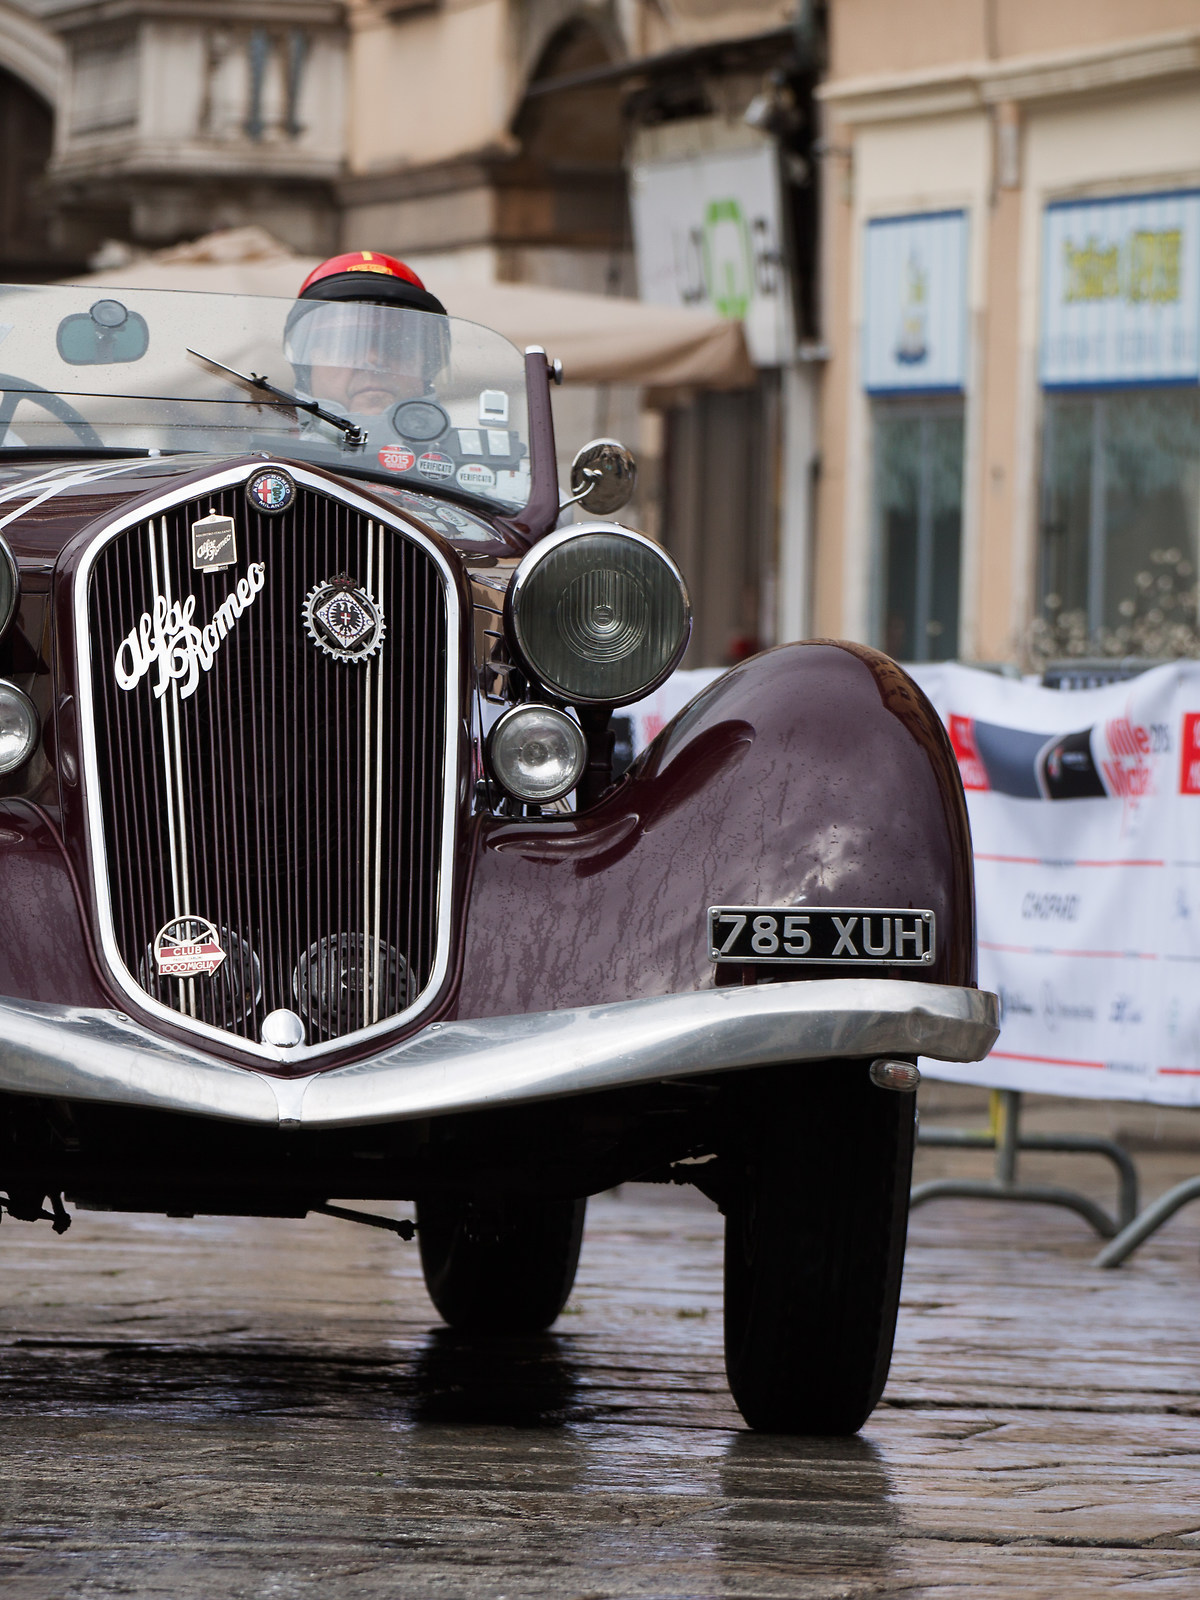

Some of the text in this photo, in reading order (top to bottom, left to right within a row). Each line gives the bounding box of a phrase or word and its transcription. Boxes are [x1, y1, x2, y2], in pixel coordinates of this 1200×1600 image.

[384, 454, 409, 464] 2015
[420, 460, 452, 473] VERIFICATO
[460, 473, 492, 483] VERIFICATO
[259, 500, 285, 509] MILANO
[115, 562, 266, 700] Alfa Romeo
[718, 914, 924, 957] 785 XUH
[173, 946, 202, 956] CLUB
[162, 960, 215, 973] 1000 MIGLIA
